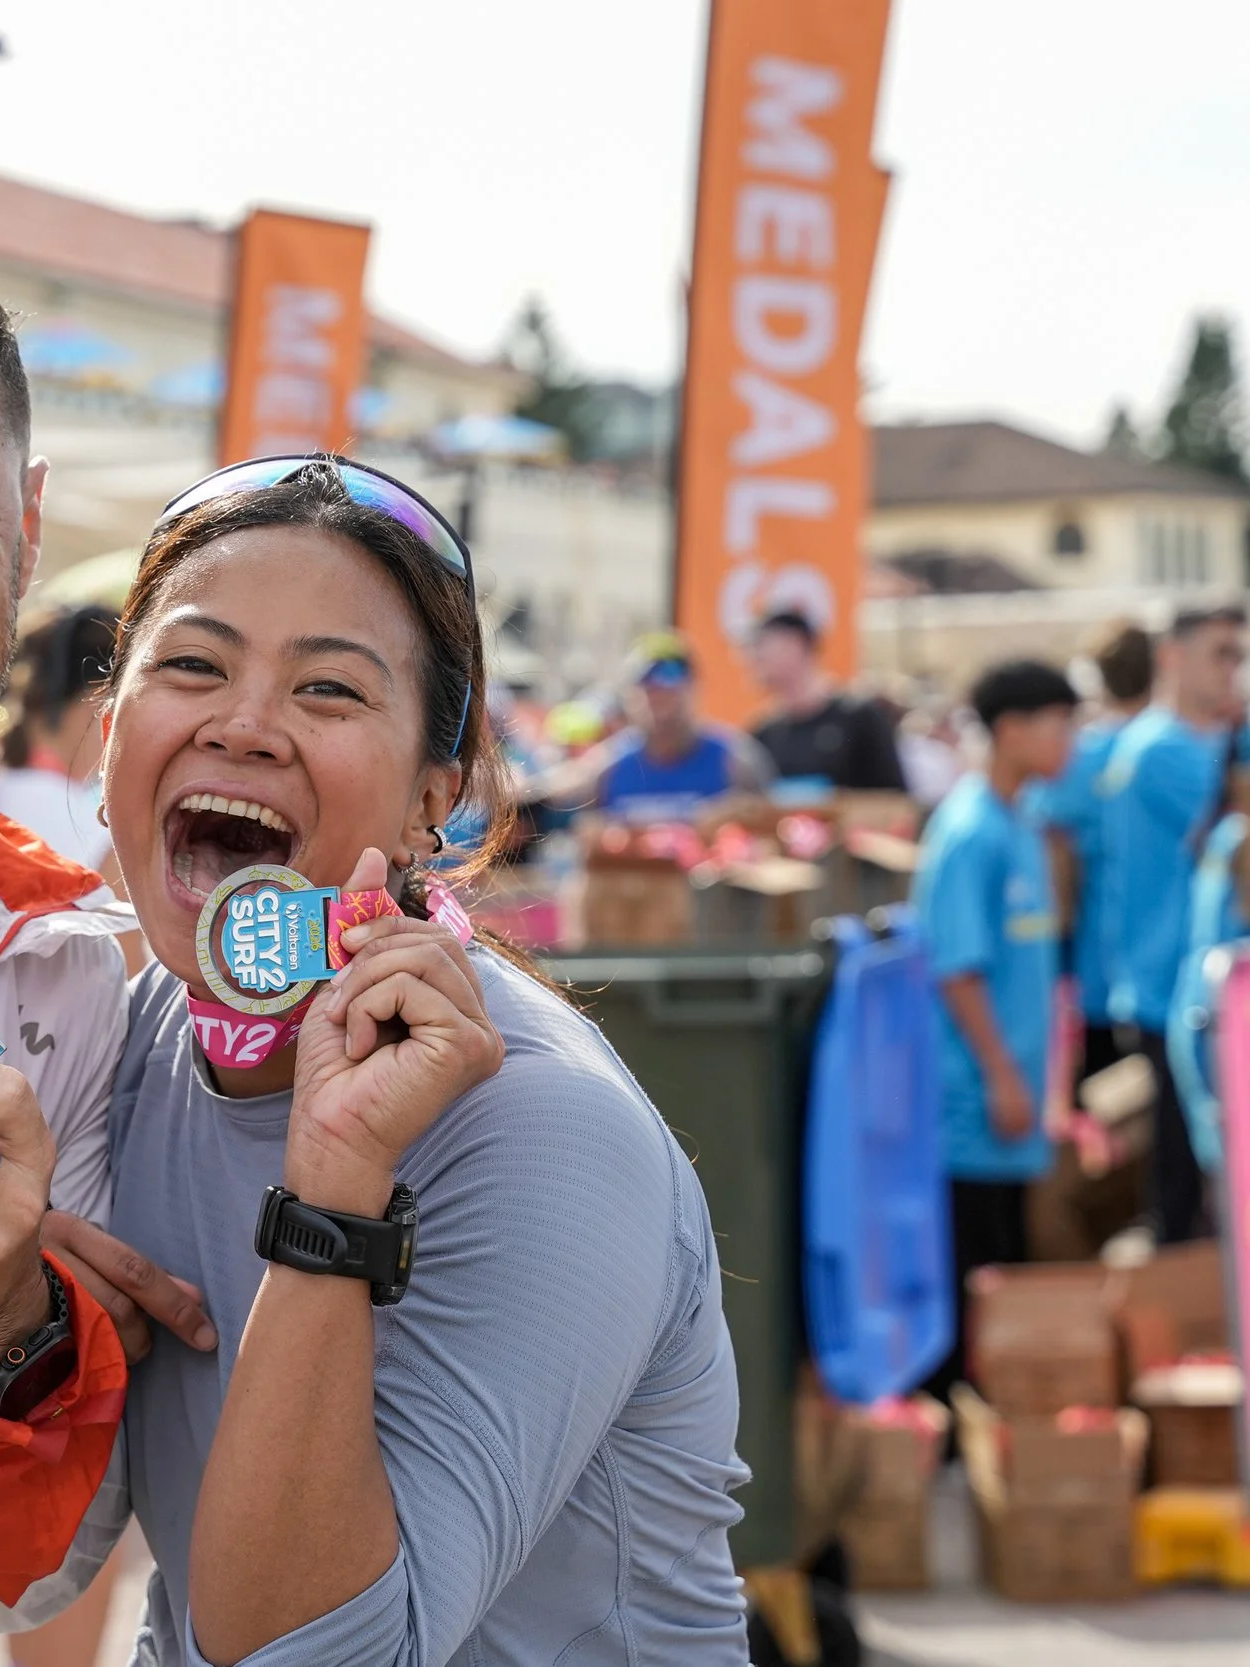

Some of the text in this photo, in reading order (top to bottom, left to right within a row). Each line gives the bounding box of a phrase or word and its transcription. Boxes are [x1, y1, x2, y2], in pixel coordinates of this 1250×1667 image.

[716, 55, 844, 655] MEDALS
[231, 899, 257, 985] SURF
[288, 919, 299, 971] Voltaren
[307, 918, 323, 952] 2026
